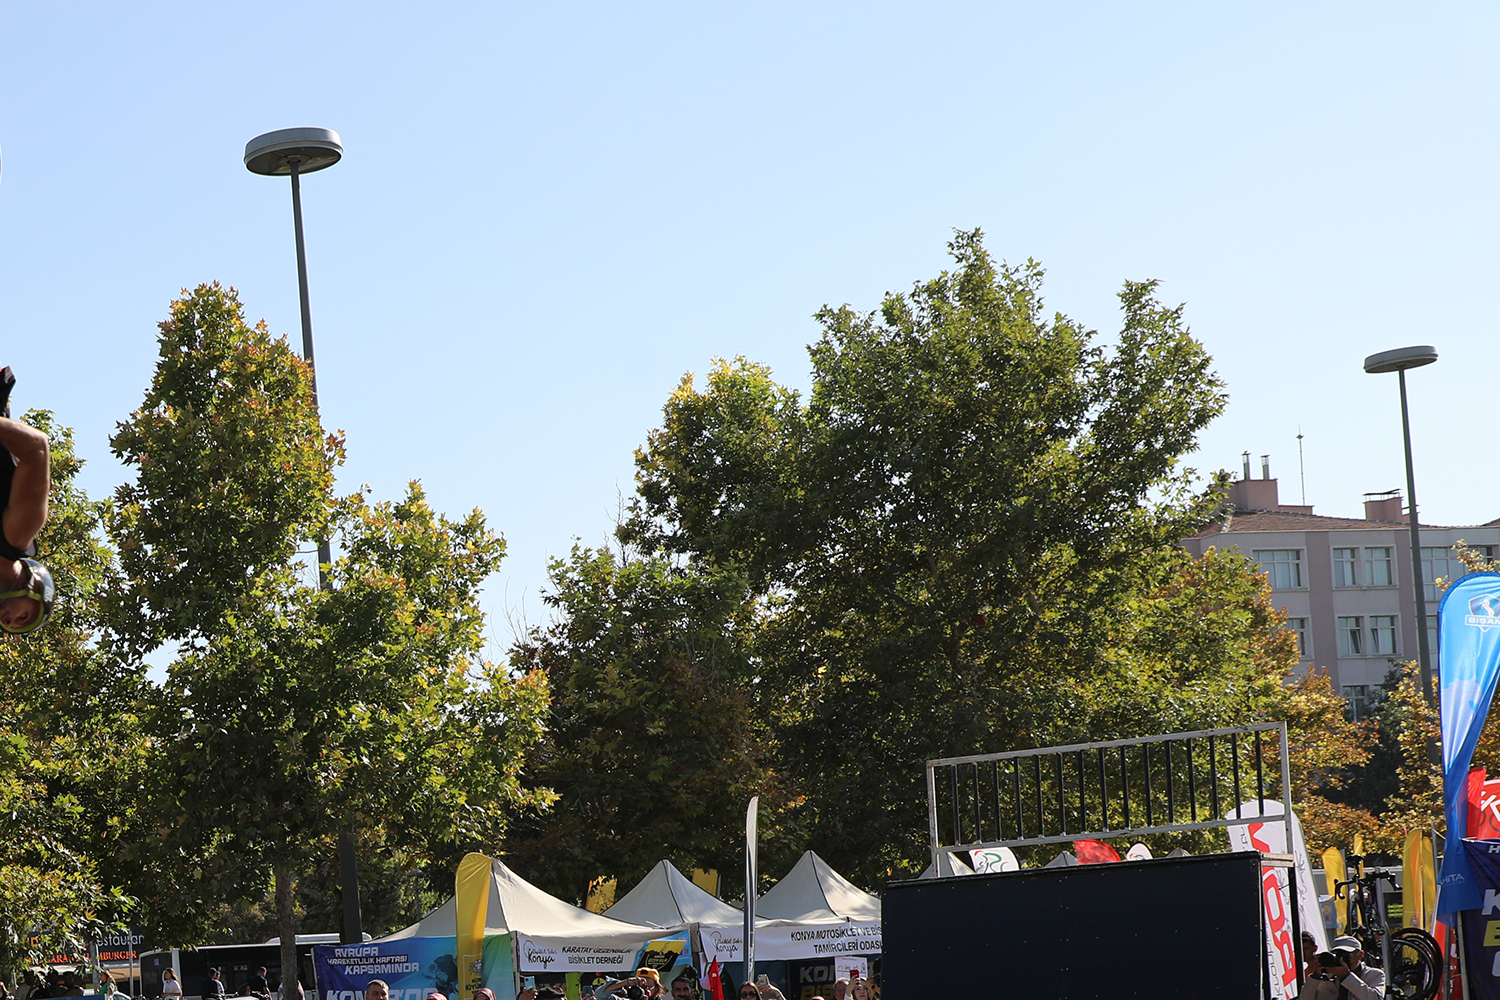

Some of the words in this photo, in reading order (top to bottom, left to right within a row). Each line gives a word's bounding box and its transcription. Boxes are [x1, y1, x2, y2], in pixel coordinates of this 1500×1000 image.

[790, 931, 815, 942] KONYA
[334, 946, 379, 958] AVRUPA
[561, 945, 593, 954] KARATAY
[813, 941, 858, 954] TAMİRCİLERİ
[375, 955, 407, 964] HAFTASI
[568, 955, 595, 965] BİSİKLET
[596, 955, 624, 965] DERNEĞİ
[344, 962, 419, 975] KAPSAMINDA
